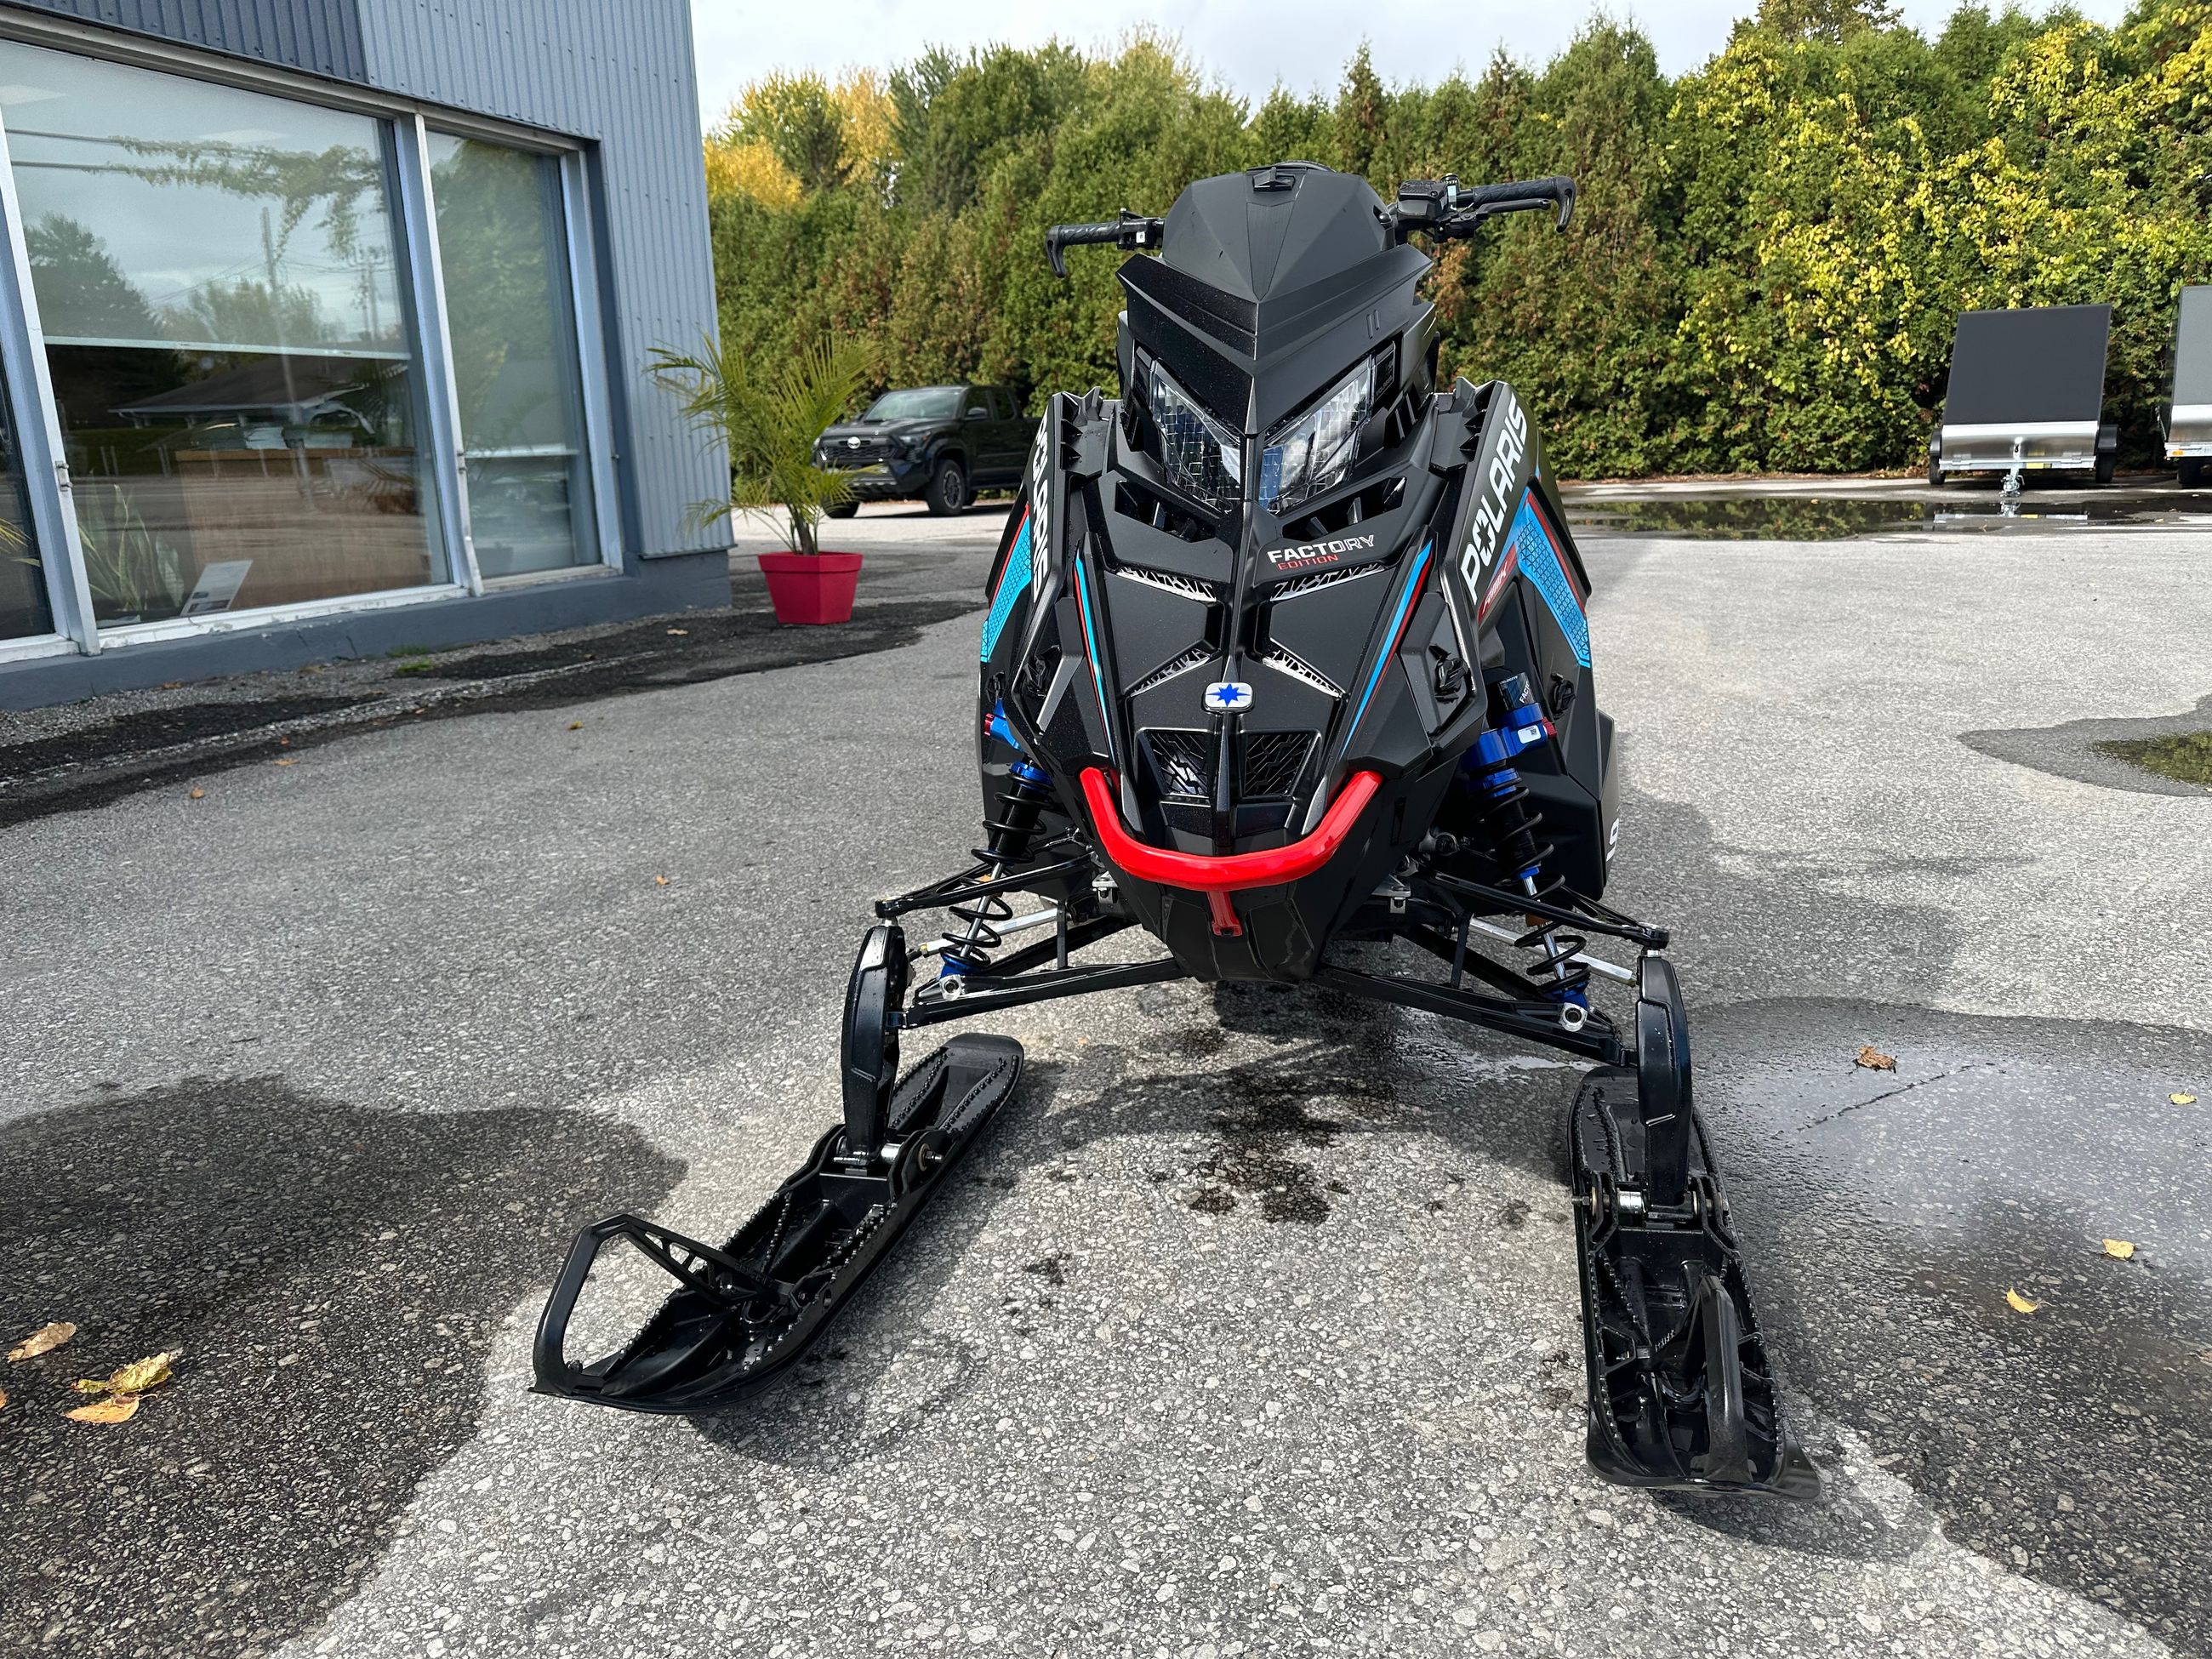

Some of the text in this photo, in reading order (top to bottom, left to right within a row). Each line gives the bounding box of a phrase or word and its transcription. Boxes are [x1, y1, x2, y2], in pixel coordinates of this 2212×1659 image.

[1461, 392, 1527, 605] POLARIS
[1267, 534, 1375, 563] FACTORY
[1277, 554, 1339, 571] EDITION
